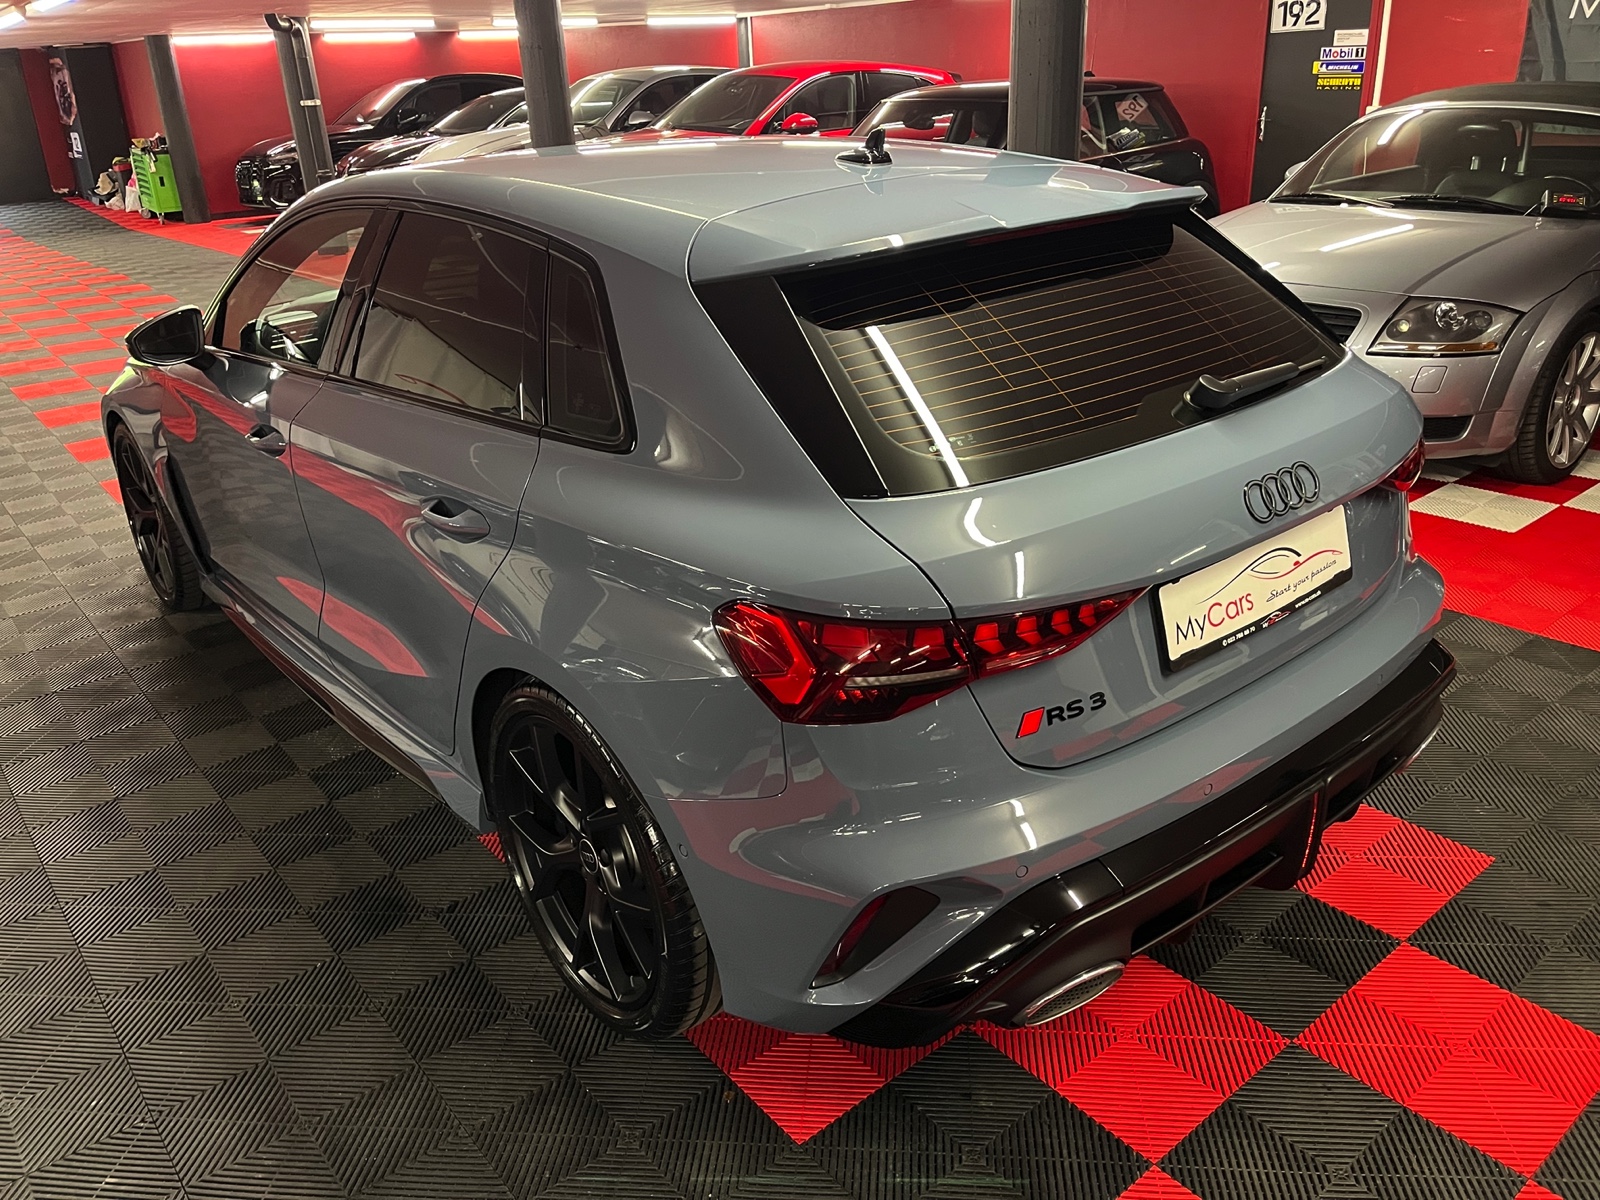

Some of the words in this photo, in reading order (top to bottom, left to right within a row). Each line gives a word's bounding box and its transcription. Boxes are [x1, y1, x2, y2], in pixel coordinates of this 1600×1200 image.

[1278, 0, 1321, 27] 192
[1322, 48, 1353, 59] Mobil
[1355, 48, 1365, 58] 1
[1317, 78, 1361, 86] SCHROTH
[1266, 584, 1291, 603] Start
[1293, 575, 1310, 592] your
[1311, 560, 1336, 582] passion
[1176, 593, 1254, 645] MyCars
[1046, 699, 1085, 727] RS
[1089, 691, 1107, 711] 3
